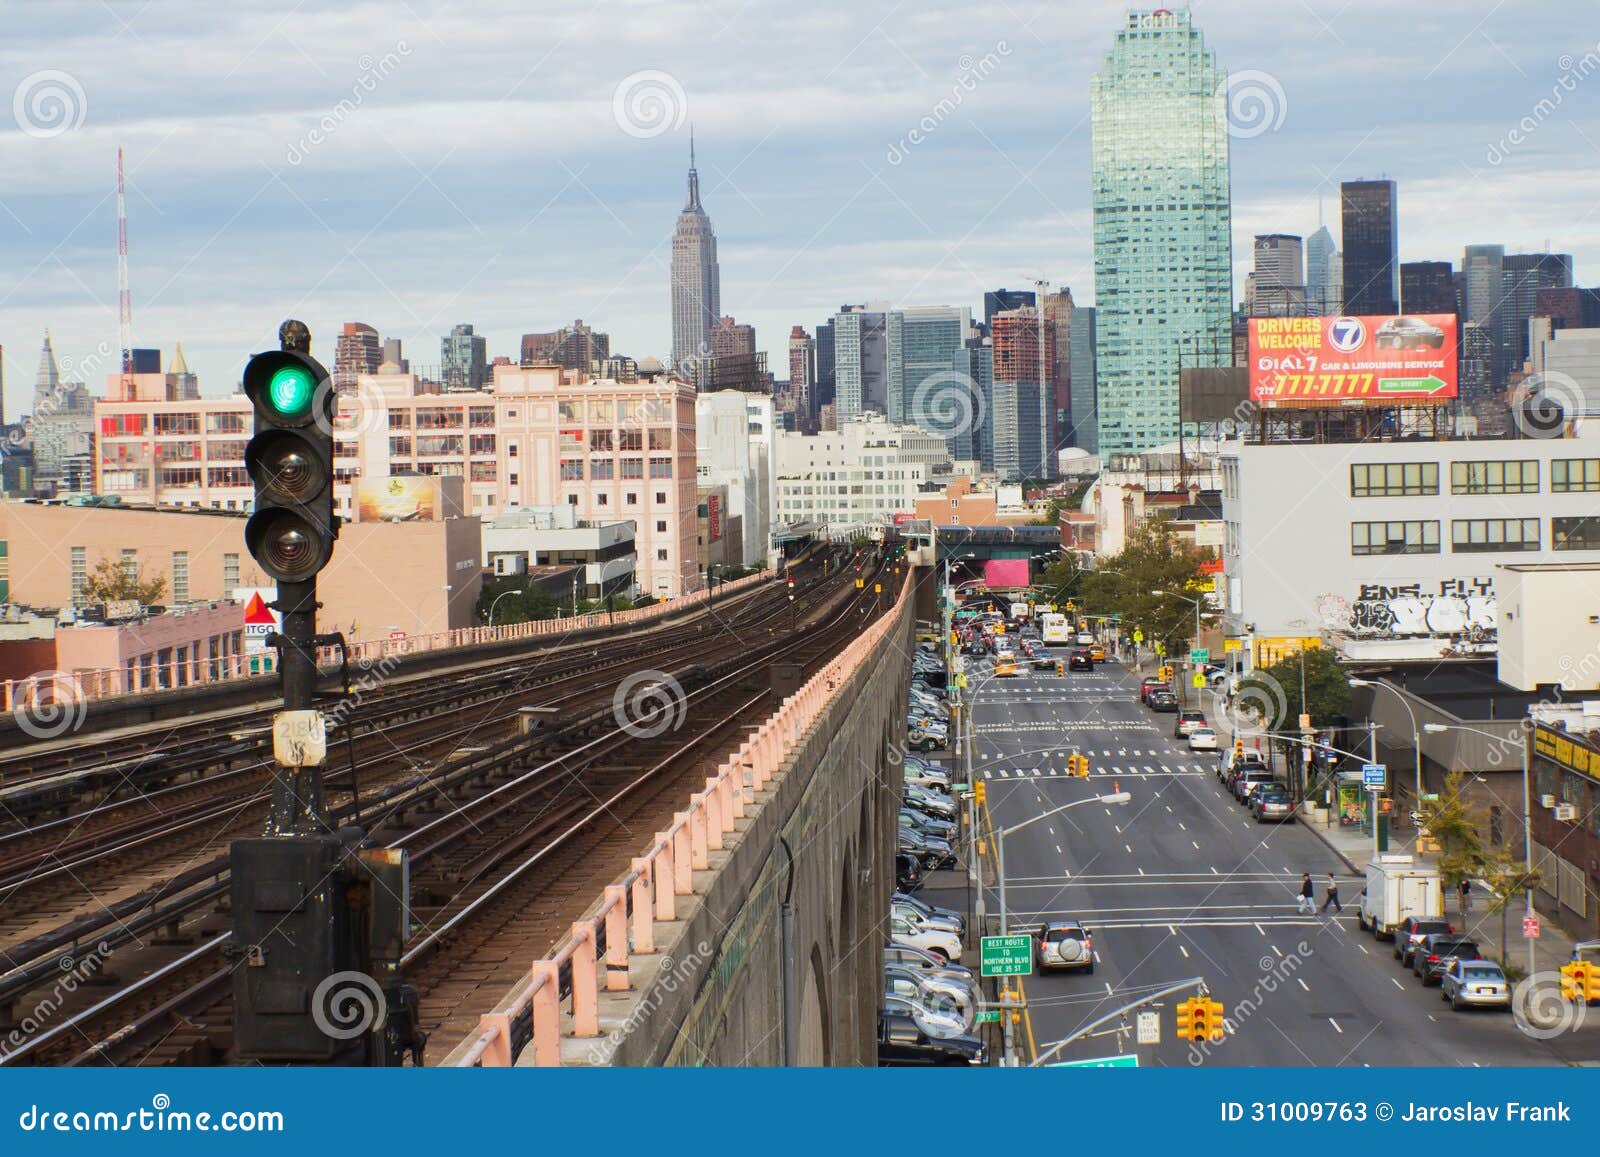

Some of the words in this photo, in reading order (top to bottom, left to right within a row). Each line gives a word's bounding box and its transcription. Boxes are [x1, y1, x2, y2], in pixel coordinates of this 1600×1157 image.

[1258, 318, 1321, 333] DRIVERS
[1335, 321, 1359, 348] 7
[1258, 334, 1321, 349] WELCOME
[1321, 362, 1340, 370] CAR
[1351, 361, 1403, 370] LIMOUSINE
[1404, 360, 1445, 369] SERVICE
[1274, 373, 1375, 395] 777-7777
[247, 624, 275, 634] ITGO
[1005, 938, 1024, 946] ROUTE
[984, 957, 1012, 965] NORTHERN
[1014, 956, 1028, 964] BLVD
